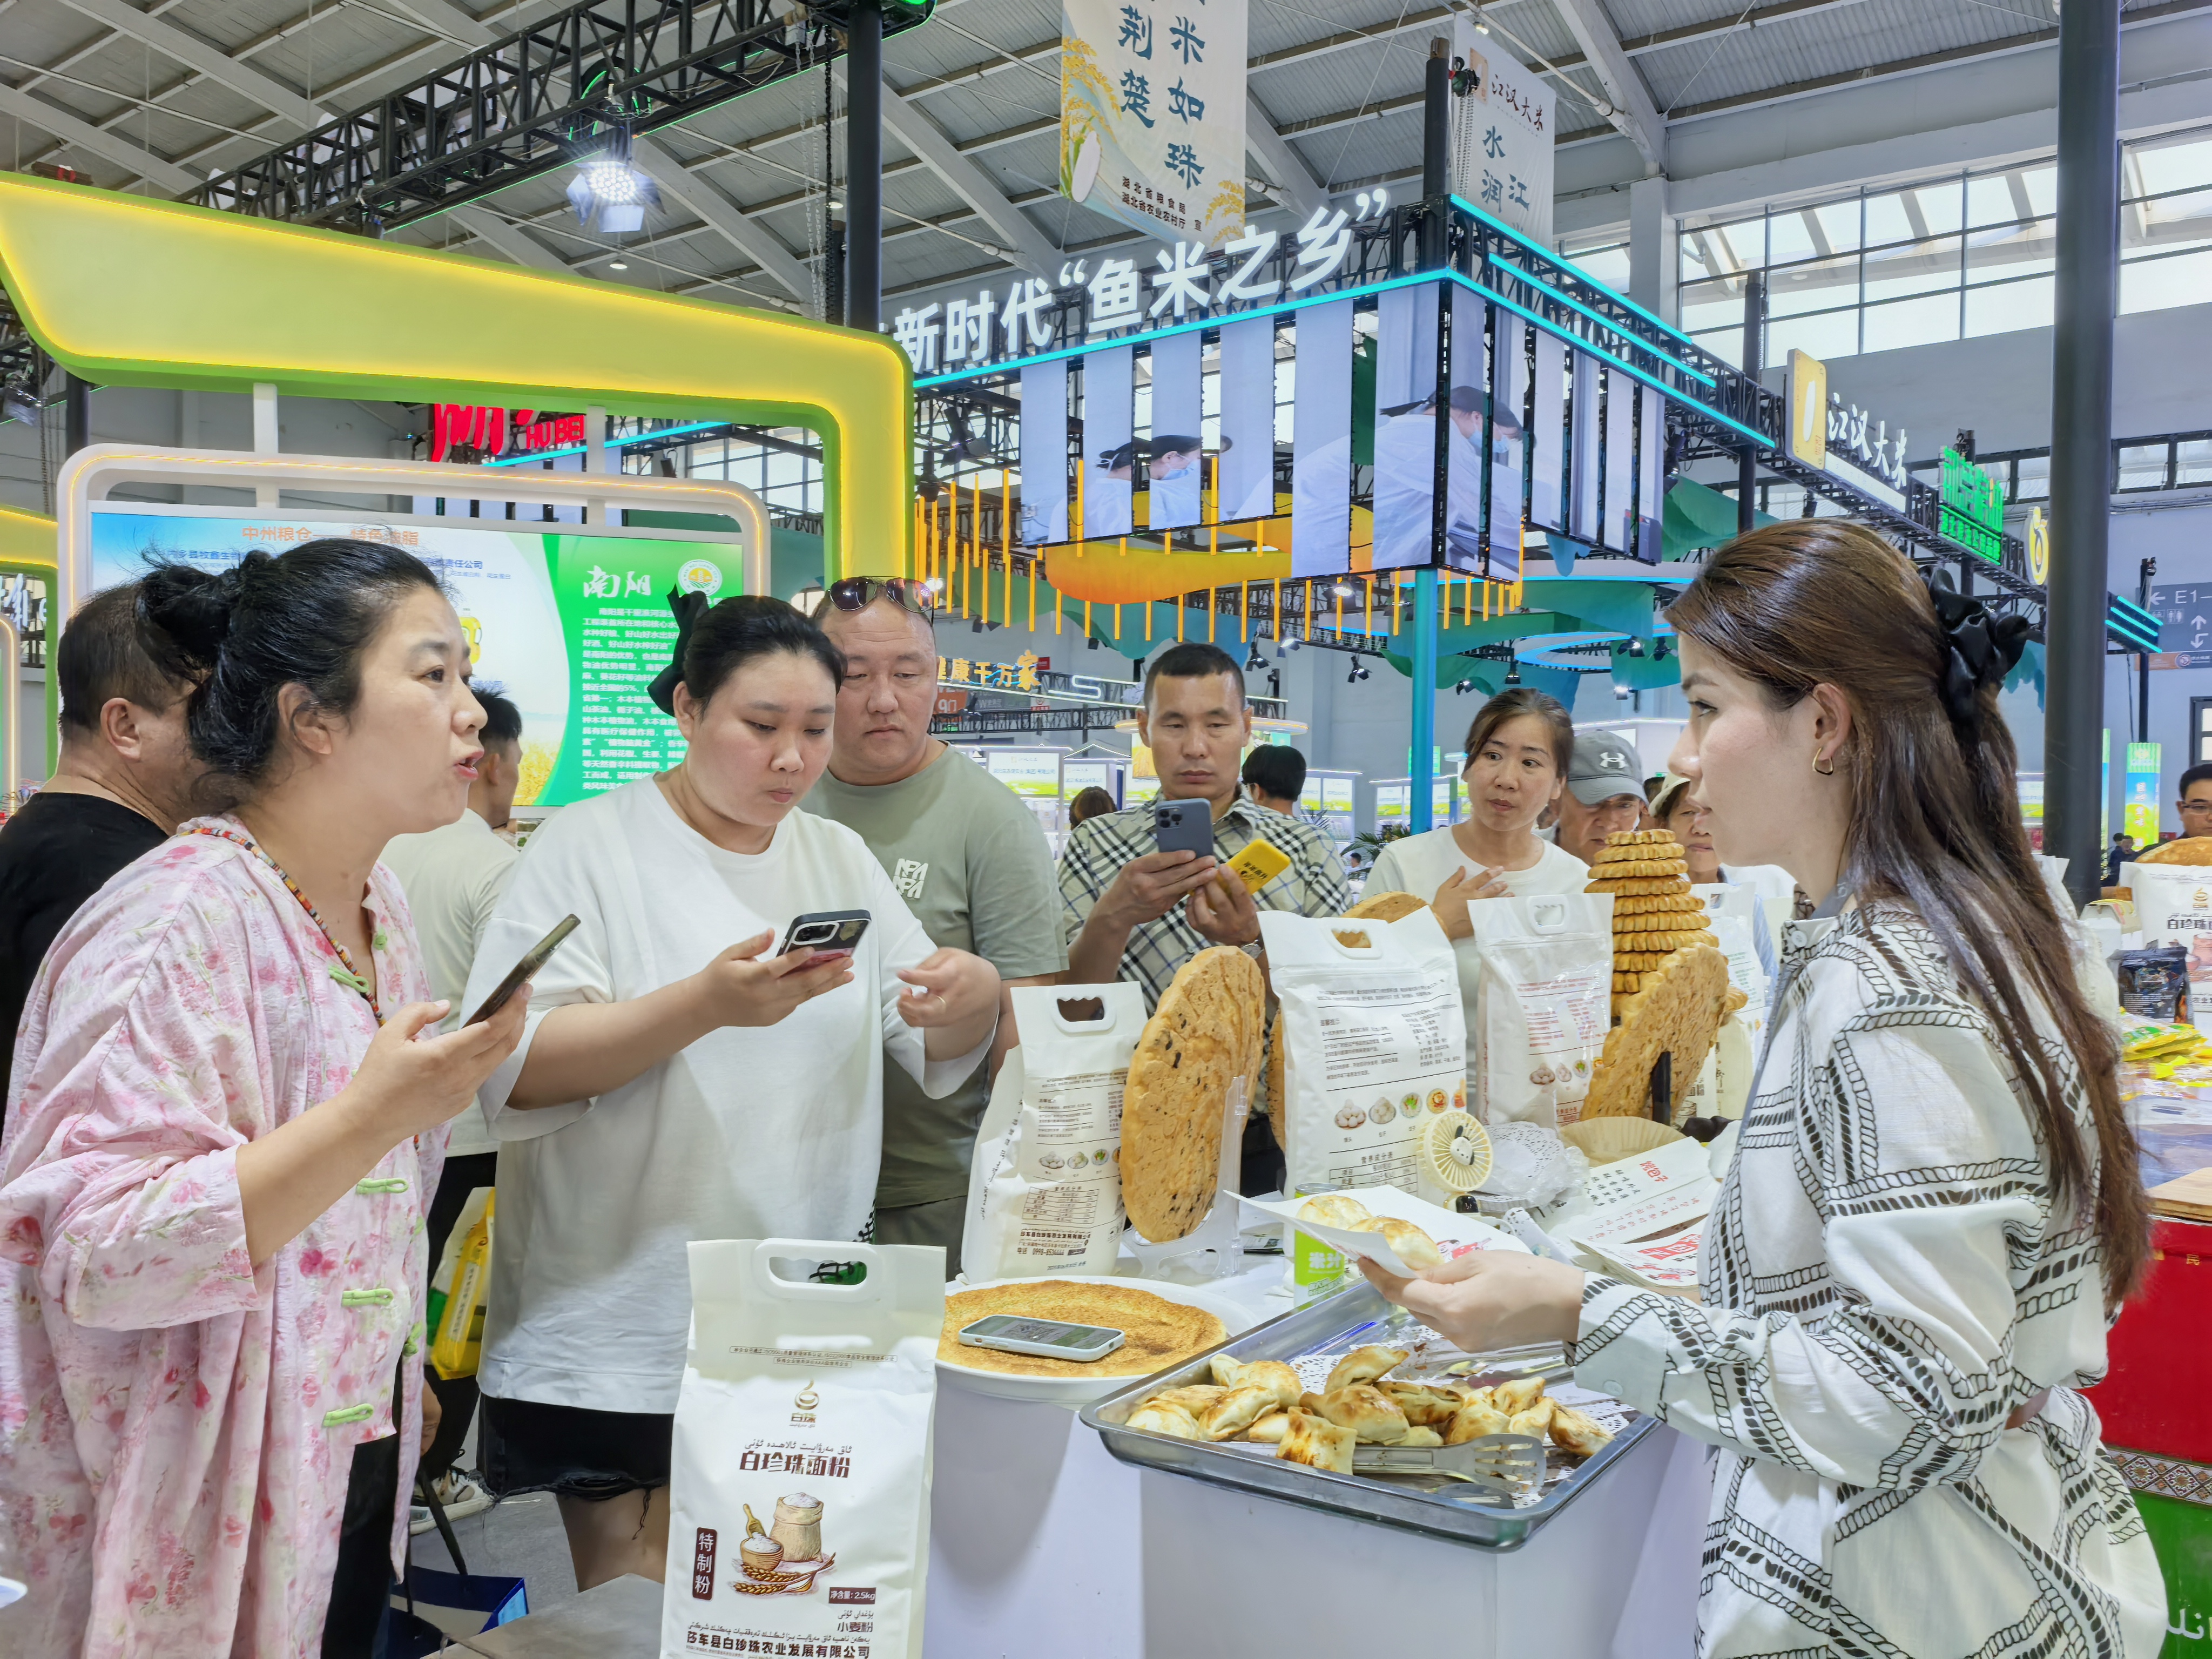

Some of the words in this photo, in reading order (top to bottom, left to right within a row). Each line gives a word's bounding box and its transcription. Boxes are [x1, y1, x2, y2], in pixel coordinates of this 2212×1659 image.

[1118, 5, 1155, 129] 荆楚
[1164, 15, 1205, 190] 米如珠
[1491, 73, 1543, 132] 江汉大米
[1481, 125, 1507, 213] 水润
[1827, 392, 1907, 490] 江汉大米
[583, 565, 651, 598] 南阳
[2167, 919, 2212, 929] 白珍珠
[1640, 1161, 1669, 1183] 烤包子
[739, 1450, 851, 1479] 白珍珠面粉
[694, 1532, 714, 1594] 特制粉
[837, 1621, 873, 1633] 小麦粉
